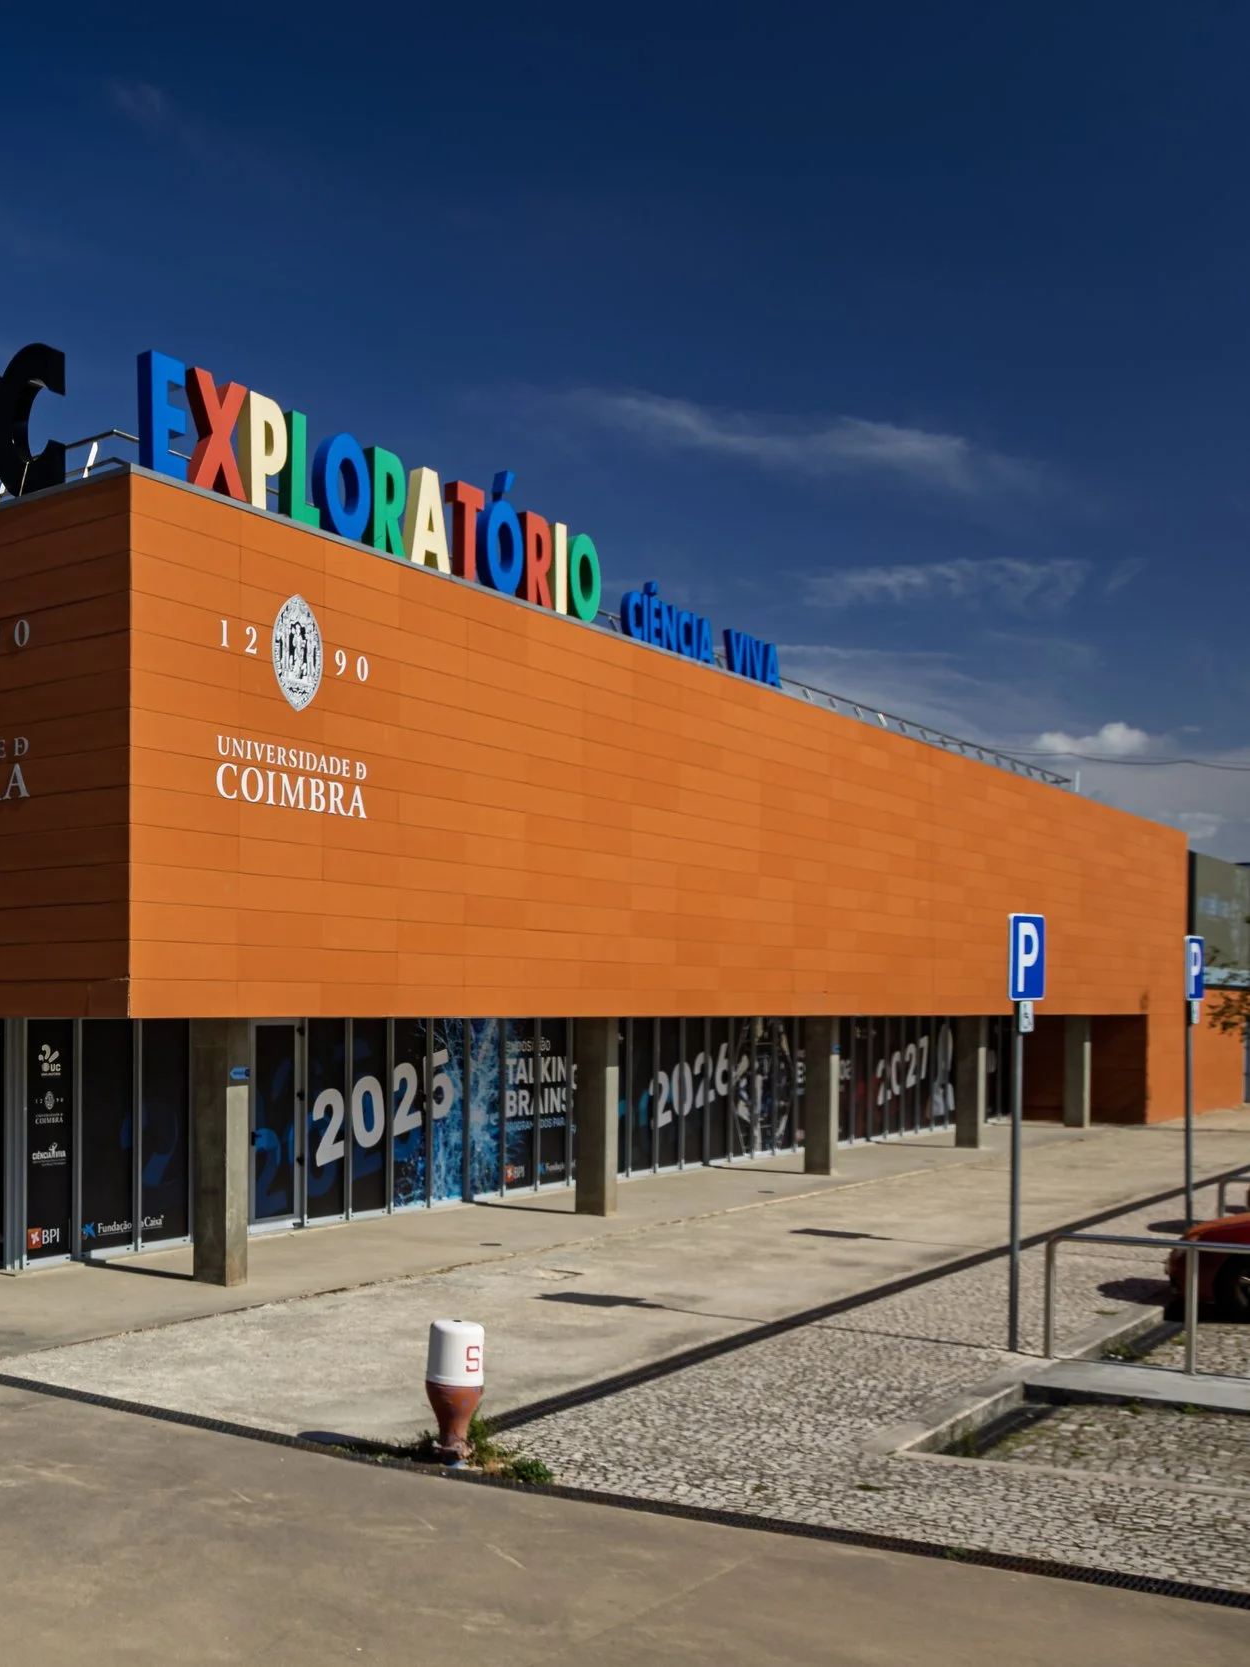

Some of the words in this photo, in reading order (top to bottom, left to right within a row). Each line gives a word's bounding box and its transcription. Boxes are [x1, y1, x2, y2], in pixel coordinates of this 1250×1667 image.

[137, 349, 601, 623] EXPLORATÓRIO
[723, 628, 782, 689] VIVA
[217, 735, 350, 778] UNIVERSIDADE
[216, 762, 367, 819] COIMBRA
[1017, 922, 1039, 993] P
[1189, 942, 1202, 995] P
[50, 1063, 61, 1072] UC
[648, 1042, 731, 1129] 2026
[313, 1049, 454, 1167] 2025
[42, 1228, 60, 1245] BPI
[97, 1220, 132, 1234] Fundação
